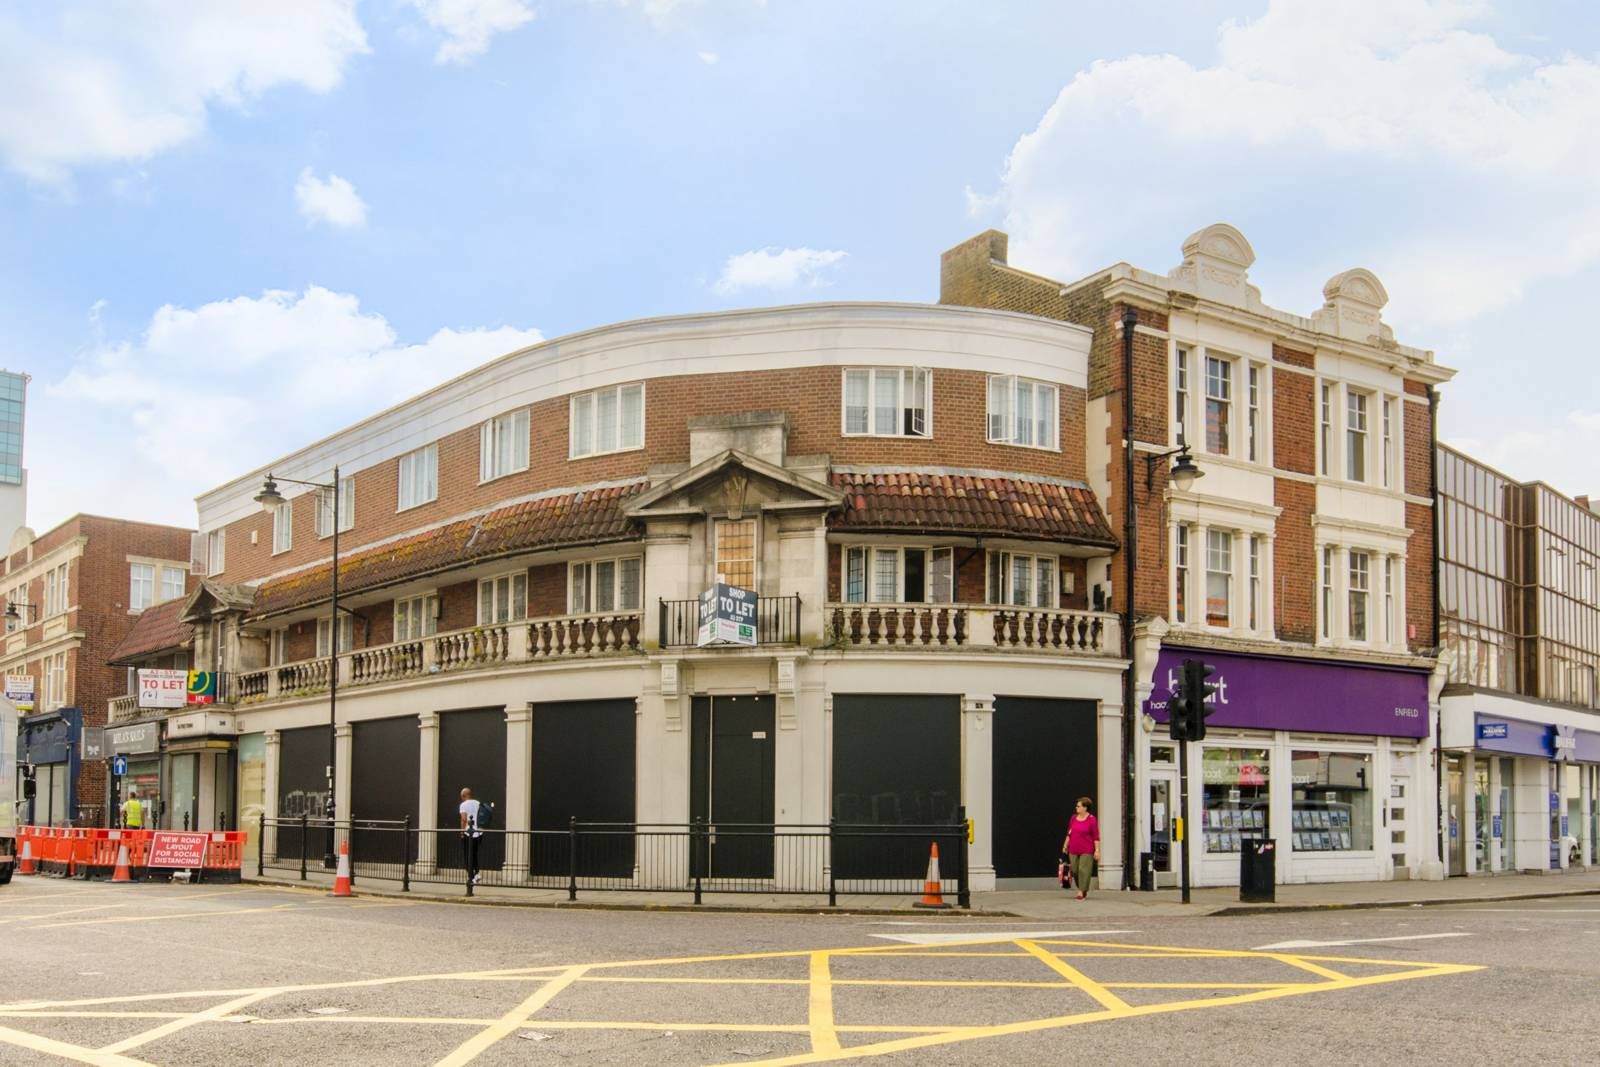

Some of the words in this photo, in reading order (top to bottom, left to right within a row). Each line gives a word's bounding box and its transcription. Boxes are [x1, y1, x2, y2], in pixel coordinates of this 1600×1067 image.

[720, 596, 734, 612] TO
[736, 600, 754, 617] LET
[143, 680, 158, 689] TO
[162, 680, 184, 690] LET
[1168, 668, 1229, 704] hrt
[1394, 707, 1419, 717] ENFIELD
